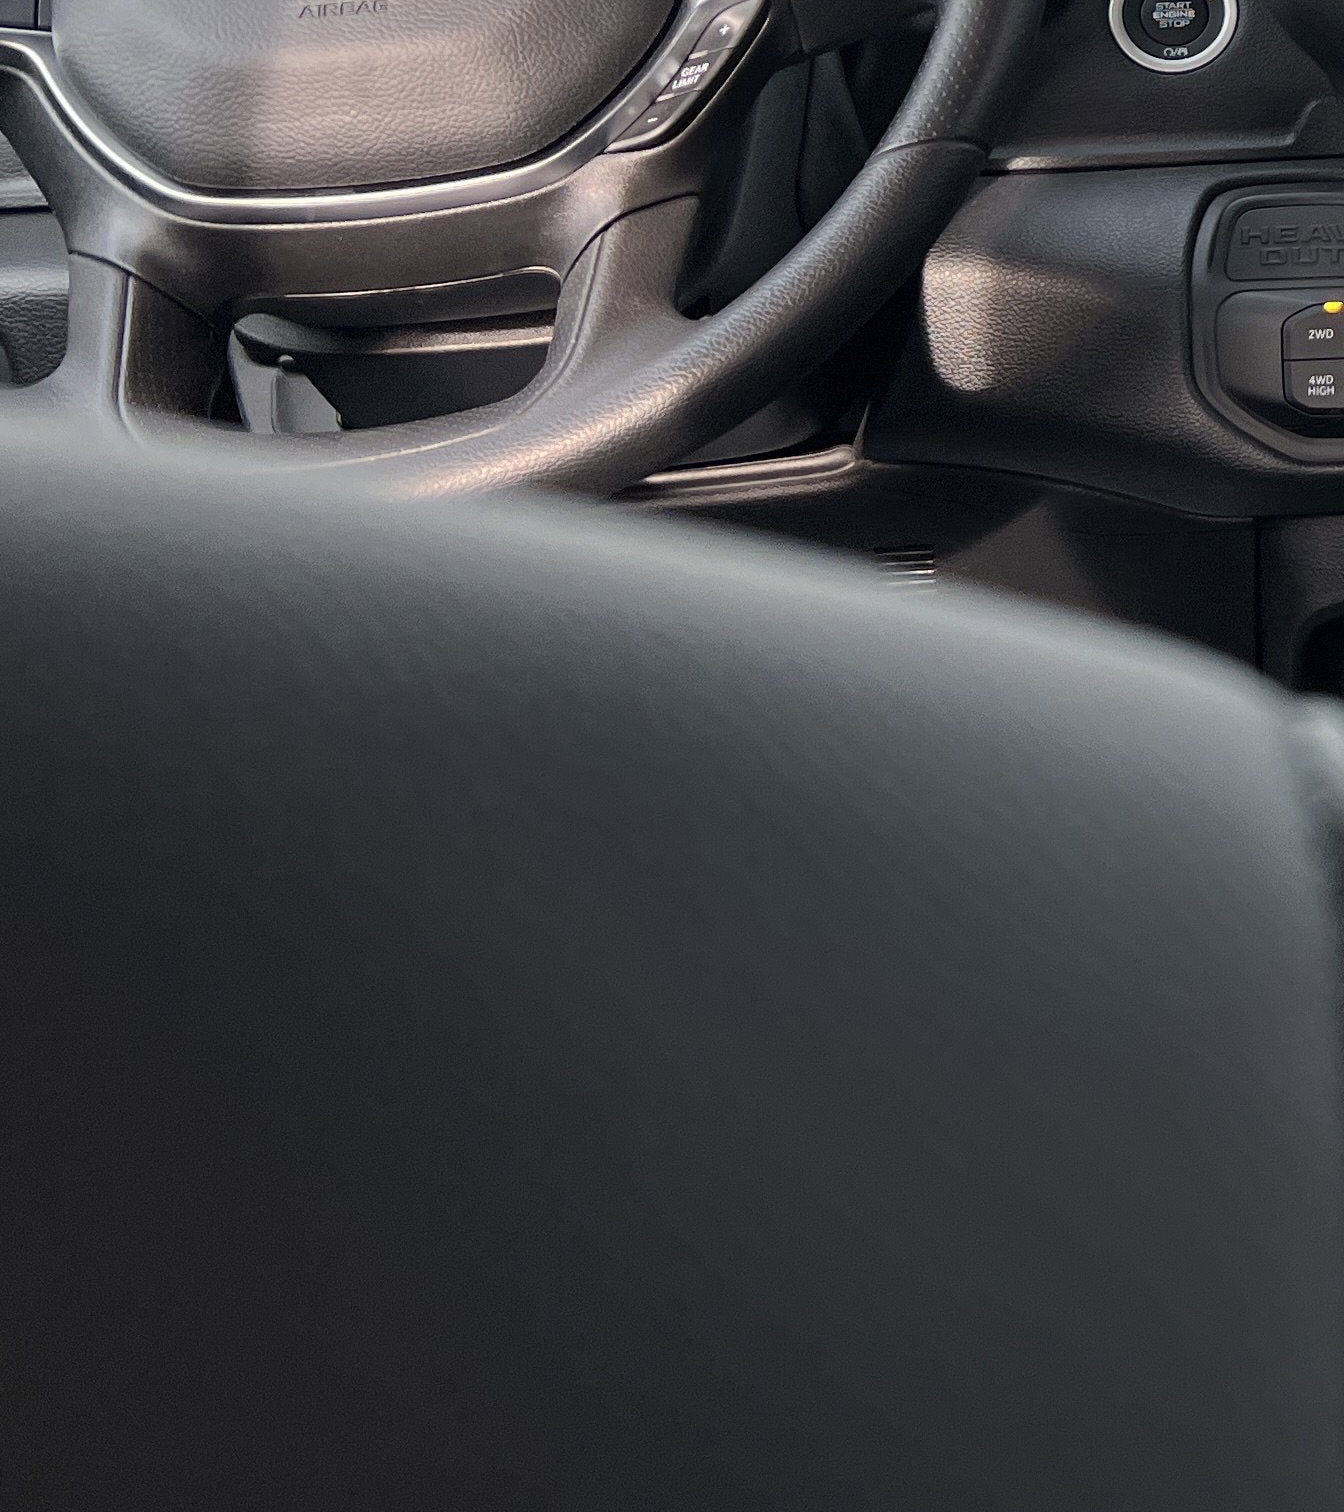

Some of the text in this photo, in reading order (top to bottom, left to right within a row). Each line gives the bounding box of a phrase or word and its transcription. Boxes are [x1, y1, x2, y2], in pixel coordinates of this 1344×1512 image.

[298, 0, 389, 19] AIRBAG
[1155, 1, 1192, 11] START
[1153, 9, 1196, 19] ENGINE
[1159, 19, 1191, 28] STOP
[681, 62, 710, 77] GEAR
[672, 74, 701, 89] LIMIT
[1308, 328, 1334, 340] 2WD
[1308, 374, 1334, 386] 4WD
[1307, 386, 1335, 397] HIGH
